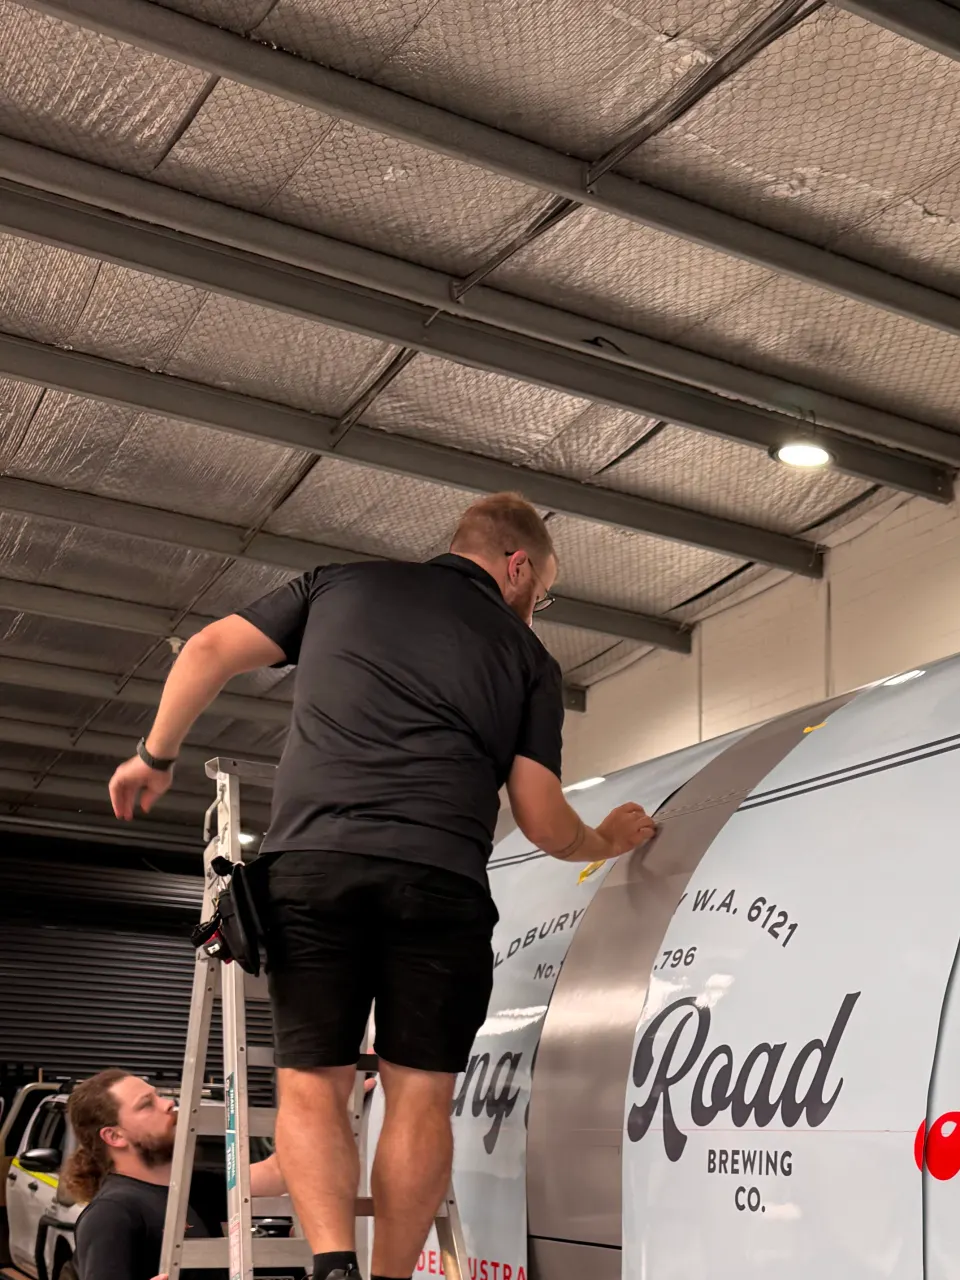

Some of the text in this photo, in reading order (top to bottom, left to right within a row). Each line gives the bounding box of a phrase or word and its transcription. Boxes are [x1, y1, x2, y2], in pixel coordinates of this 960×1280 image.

[493, 907, 585, 969] LDBURY
[692, 888, 738, 915] W.A.
[747, 896, 799, 948] 6121
[450, 1051, 523, 1155] ng
[627, 991, 862, 1162] Road
[707, 1149, 793, 1177] BREWING
[735, 1186, 766, 1213] CO.
